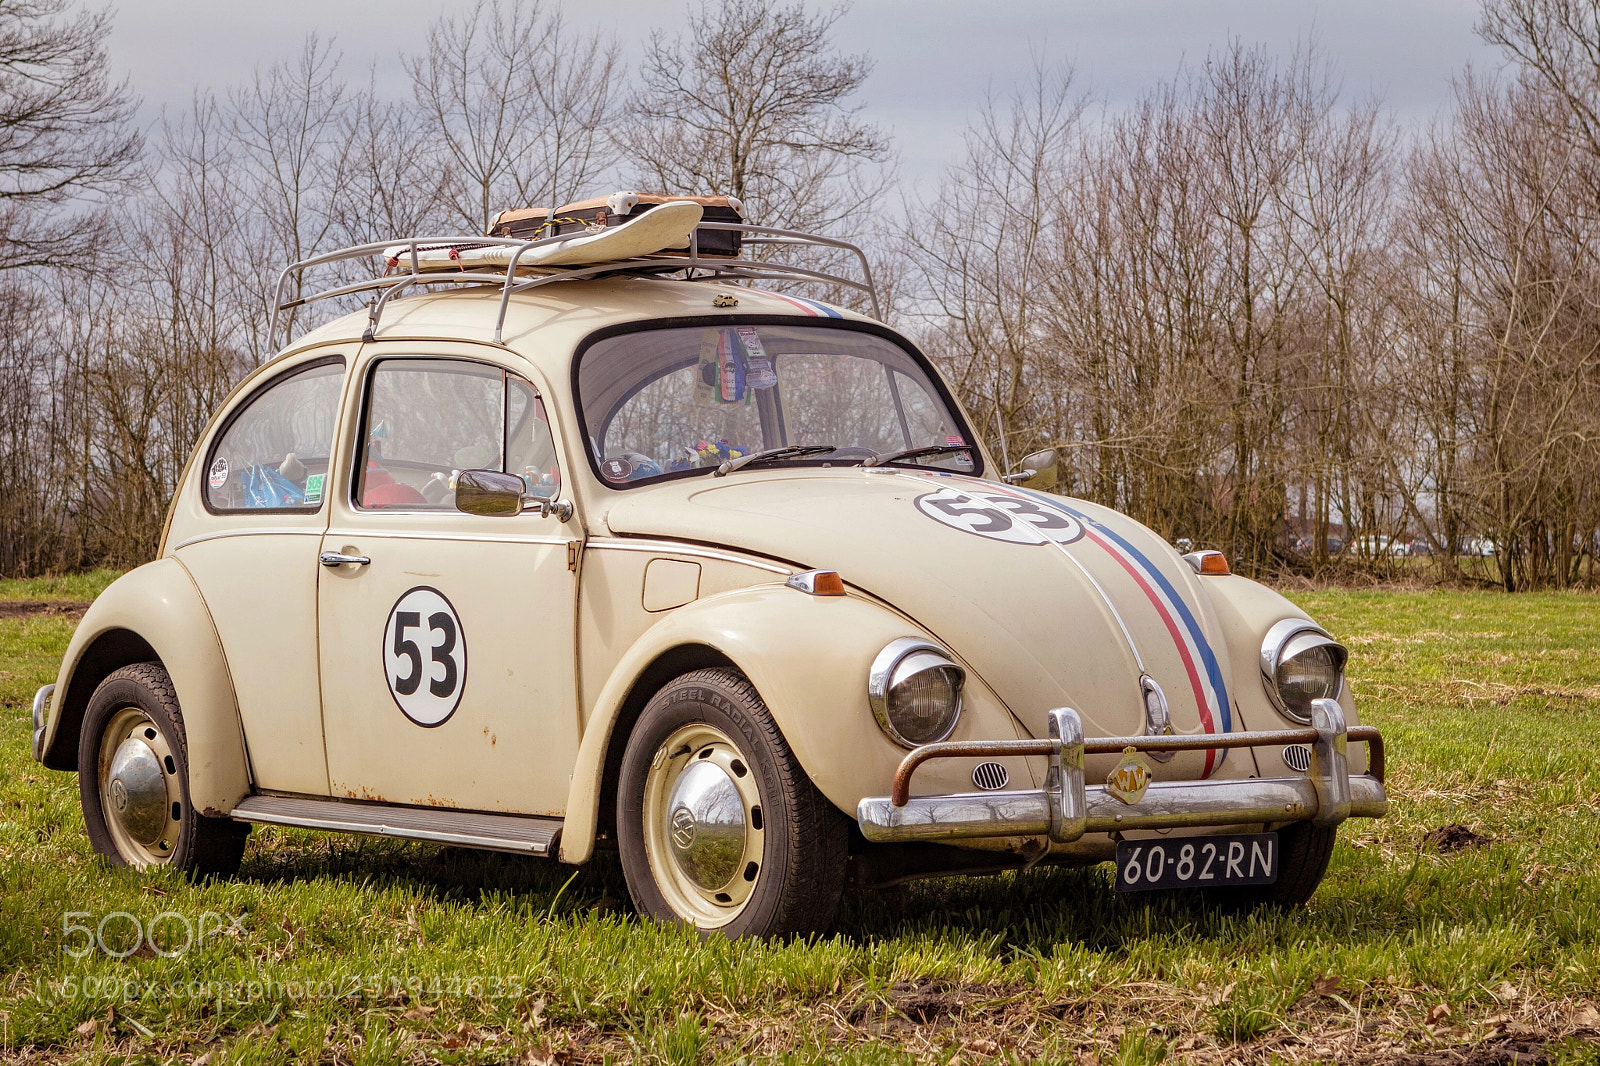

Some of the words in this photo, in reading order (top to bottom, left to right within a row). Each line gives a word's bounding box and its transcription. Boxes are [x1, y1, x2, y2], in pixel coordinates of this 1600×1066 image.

[925, 495, 1070, 533] 53
[394, 611, 458, 698] 53
[662, 689, 706, 711] STEEL
[711, 695, 761, 749] RADIAL
[1123, 840, 1273, 885] 60-82-RN
